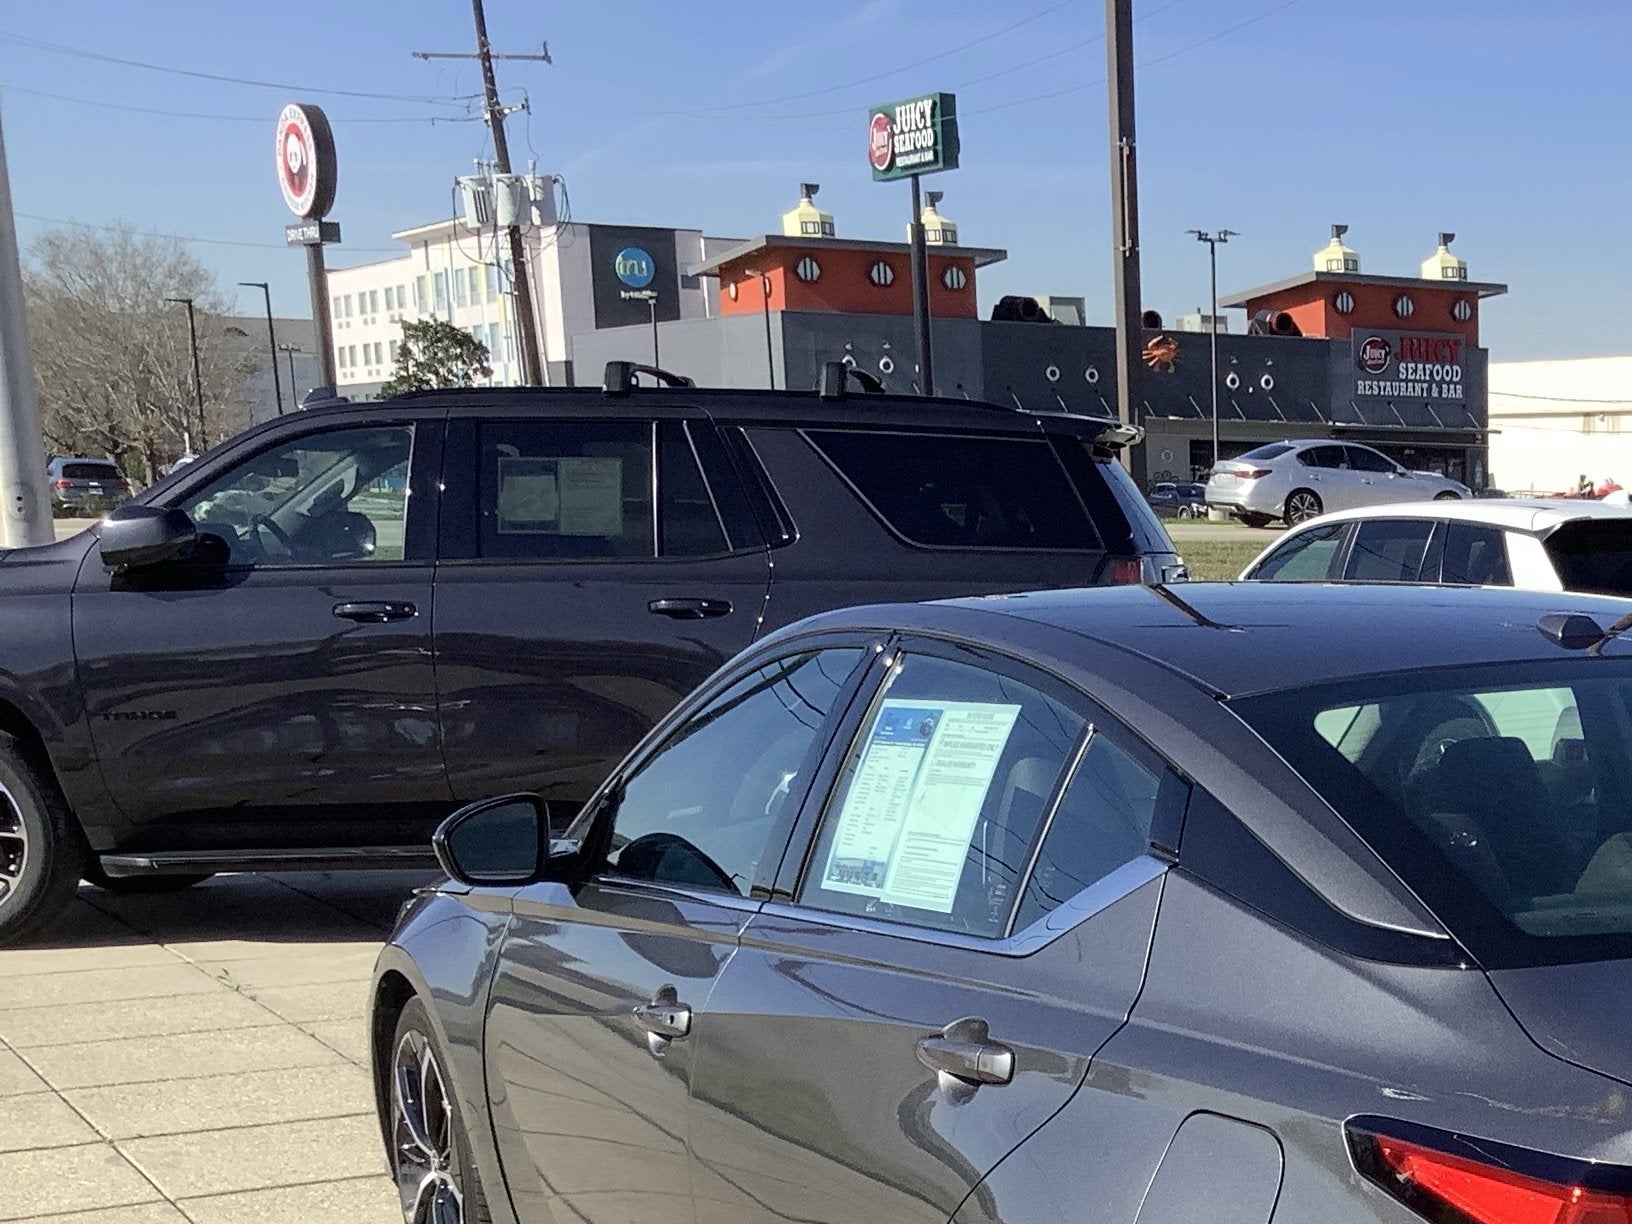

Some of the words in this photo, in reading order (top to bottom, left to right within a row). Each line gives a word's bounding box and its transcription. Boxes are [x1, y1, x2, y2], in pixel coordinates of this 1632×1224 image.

[893, 99, 933, 135] JUICY
[893, 127, 935, 154] SEAFOOD
[1396, 336, 1461, 362] JUICY
[1398, 362, 1462, 382] SEAFOOD
[1357, 380, 1429, 397] RESTAURANT
[1430, 383, 1439, 397] &
[1442, 384, 1463, 399] BAR
